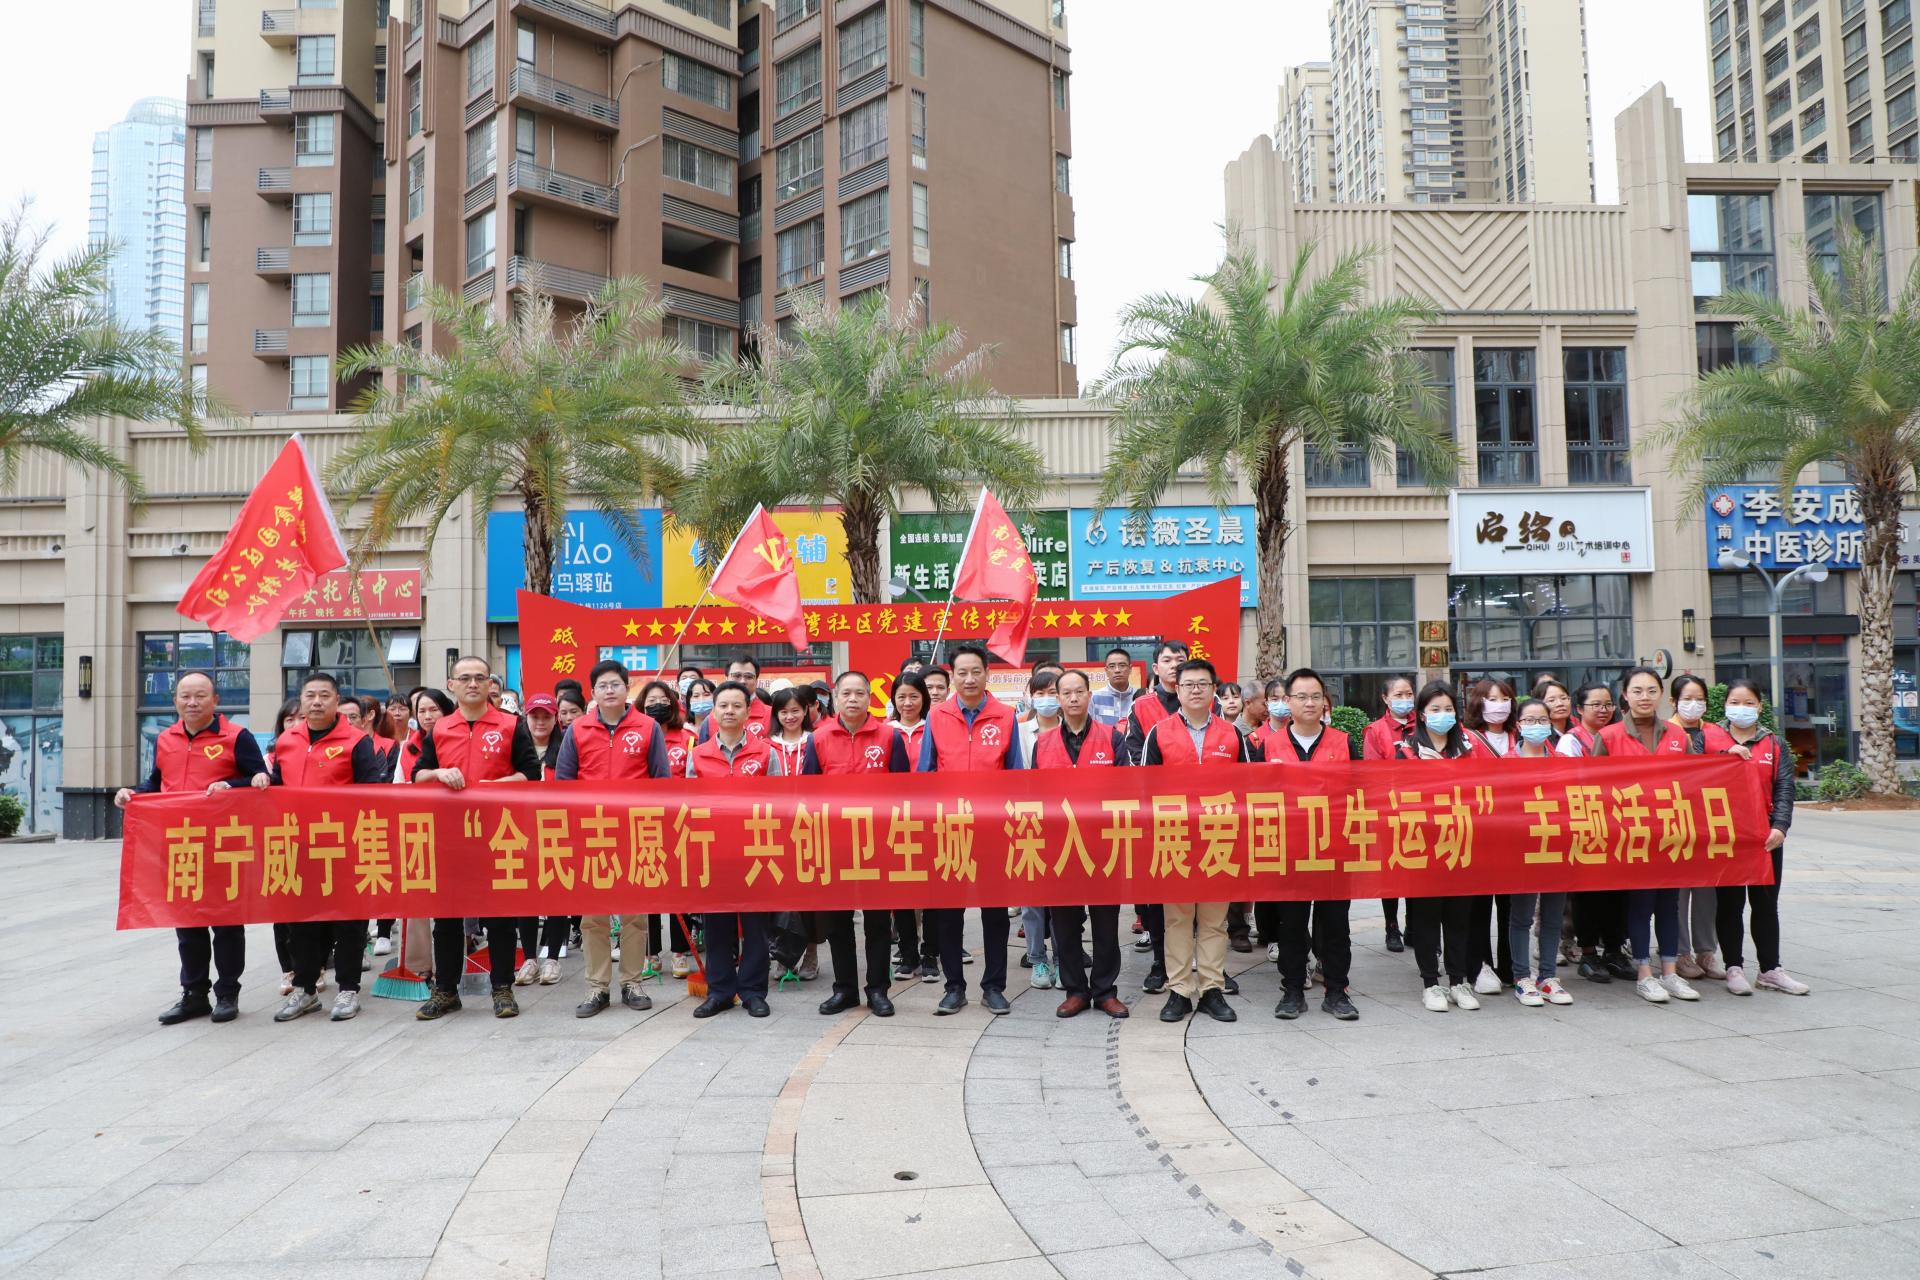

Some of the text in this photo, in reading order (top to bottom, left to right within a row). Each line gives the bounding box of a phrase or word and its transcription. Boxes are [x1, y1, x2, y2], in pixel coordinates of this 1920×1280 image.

[1743, 489, 1864, 525] 李安成
[899, 533, 963, 544] 全国连锁 免费加盟
[1476, 511, 1553, 544] 启绘
[1526, 543, 1550, 551] QIHUI
[1744, 530, 1864, 564] 中医诊所
[1087, 556, 1245, 576] 产后恢复 & 抗衰中心
[550, 572, 613, 593] 鸟驿站
[289, 608, 307, 618] 午托
[747, 605, 1017, 637] 北湾社区党建宣传栏
[550, 626, 578, 674] 砥砺
[165, 781, 1737, 903] 南宁威宁集团 “全民志愿行 共创卫生城 深入开展爱国卫生运动” 主题活动日
